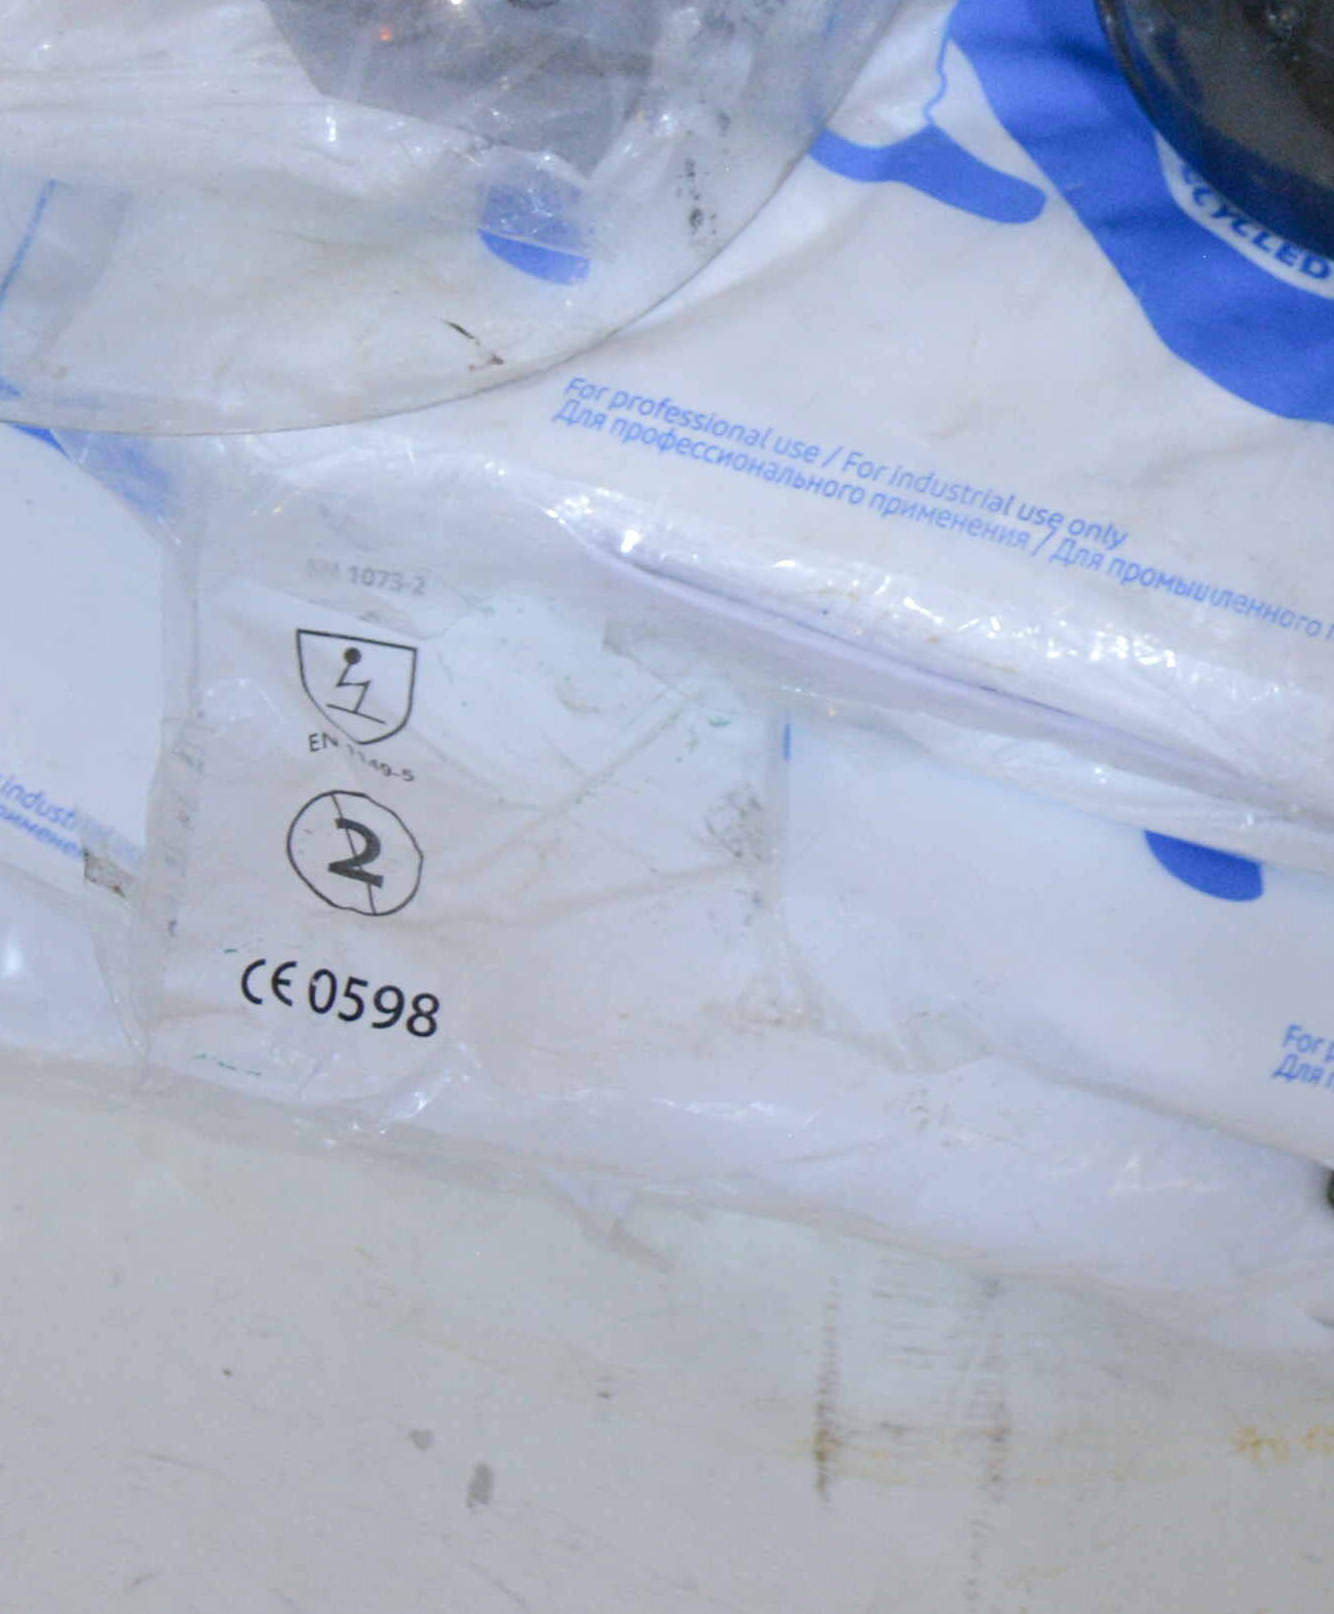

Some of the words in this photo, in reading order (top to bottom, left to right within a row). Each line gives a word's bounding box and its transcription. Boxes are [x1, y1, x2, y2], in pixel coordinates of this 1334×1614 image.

[564, 376, 611, 403] For
[607, 388, 773, 451] professional
[774, 435, 821, 464] use
[821, 445, 843, 469] /
[842, 451, 885, 481] For
[890, 463, 1012, 516] industrial
[1017, 504, 1065, 531] use
[1066, 517, 1130, 550] only
[551, 399, 608, 430] Для
[609, 414, 867, 505] профессионального
[869, 489, 1032, 551] применения
[1030, 529, 1055, 556] /
[1048, 538, 1105, 571] Для
[1107, 557, 1323, 638] промышленного
[307, 732, 338, 754] EN
[327, 817, 384, 889] 2
[307, 967, 441, 1038] 0598
[1272, 1053, 1320, 1085] Для
[1281, 1024, 1329, 1054] For
